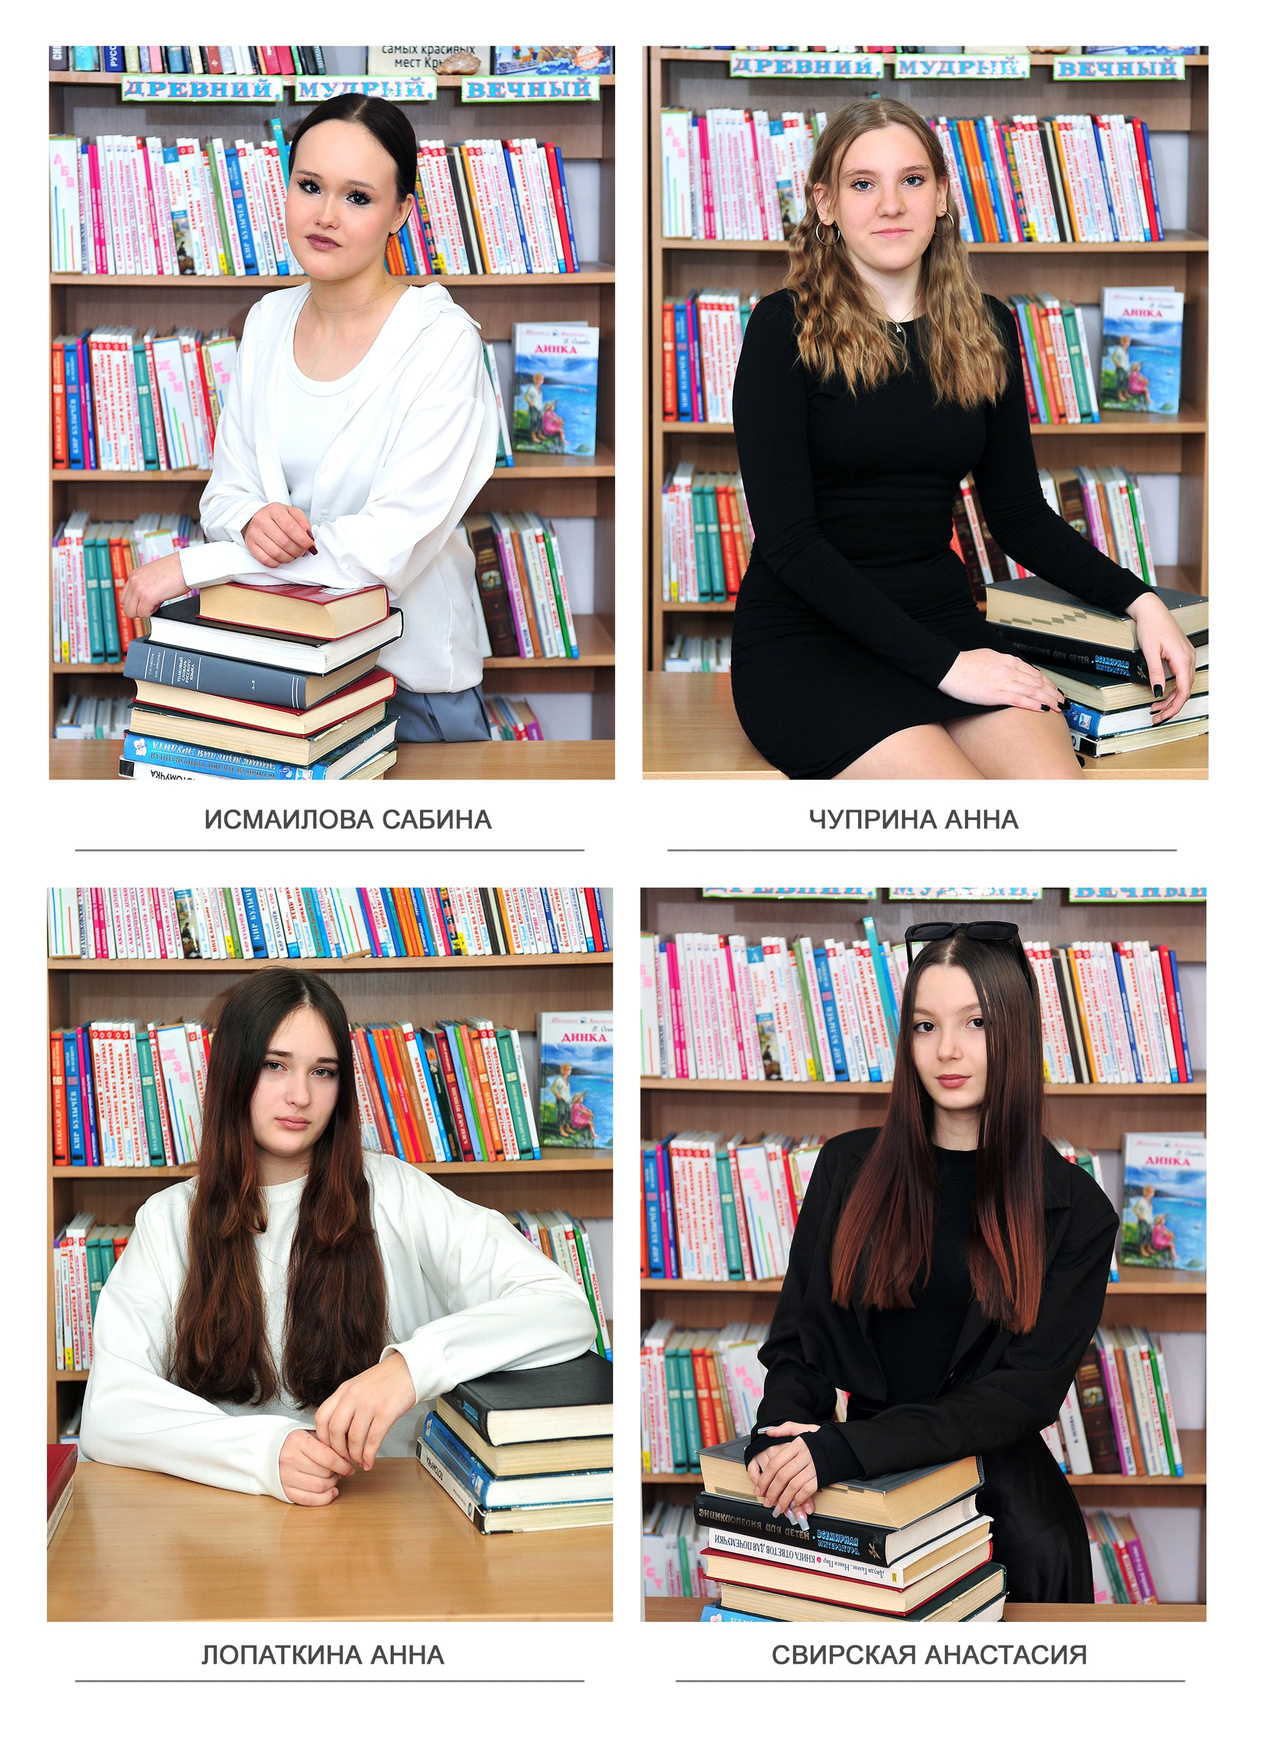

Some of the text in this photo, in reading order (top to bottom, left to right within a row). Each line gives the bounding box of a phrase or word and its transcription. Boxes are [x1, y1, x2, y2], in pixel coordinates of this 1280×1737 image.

[395, 58, 420, 68] мест
[733, 56, 1177, 78] ДРЕВНИЙ, МУДРЫЙ, ВЕЧНЫЙ
[124, 78, 281, 101] ДРЕВНИЙ,
[465, 77, 593, 99] ВЕЧНЫЙ
[237, 203, 252, 258] КИР БУЛЫЧЁВ
[1123, 308, 1163, 318] ДИНКА
[535, 345, 577, 355] ДИНКА
[151, 741, 194, 755] ЭРУДИТА
[466, 891, 474, 914] ХУТОРЕ
[505, 889, 513, 912] ХУТОРЕ
[554, 888, 562, 911] ХУТОРЕ
[252, 923, 260, 939] КИР
[273, 911, 281, 937] БУЛЫЧЁВ
[474, 926, 482, 950] ВЕЧЕРА
[561, 1033, 607, 1043] ДИНКА
[162, 1048, 177, 1061] Ж
[173, 1061, 182, 1072] З
[179, 1072, 190, 1083] И
[451, 1087, 461, 1111] ПУШКИН
[425, 1098, 434, 1123] СТАРИК
[70, 1091, 81, 1149] КИР БУЛЫЧЁВ
[488, 1108, 499, 1140] НИКОЛАЙ
[1146, 1155, 1191, 1167] ДИНКА
[715, 1534, 753, 1551] ПОЧЕМУЧКИ
[785, 1528, 810, 1541] ДЕТЕЙ
[765, 1546, 794, 1560] ОТВЕТОВ
[795, 1552, 816, 1564] КНИГА
